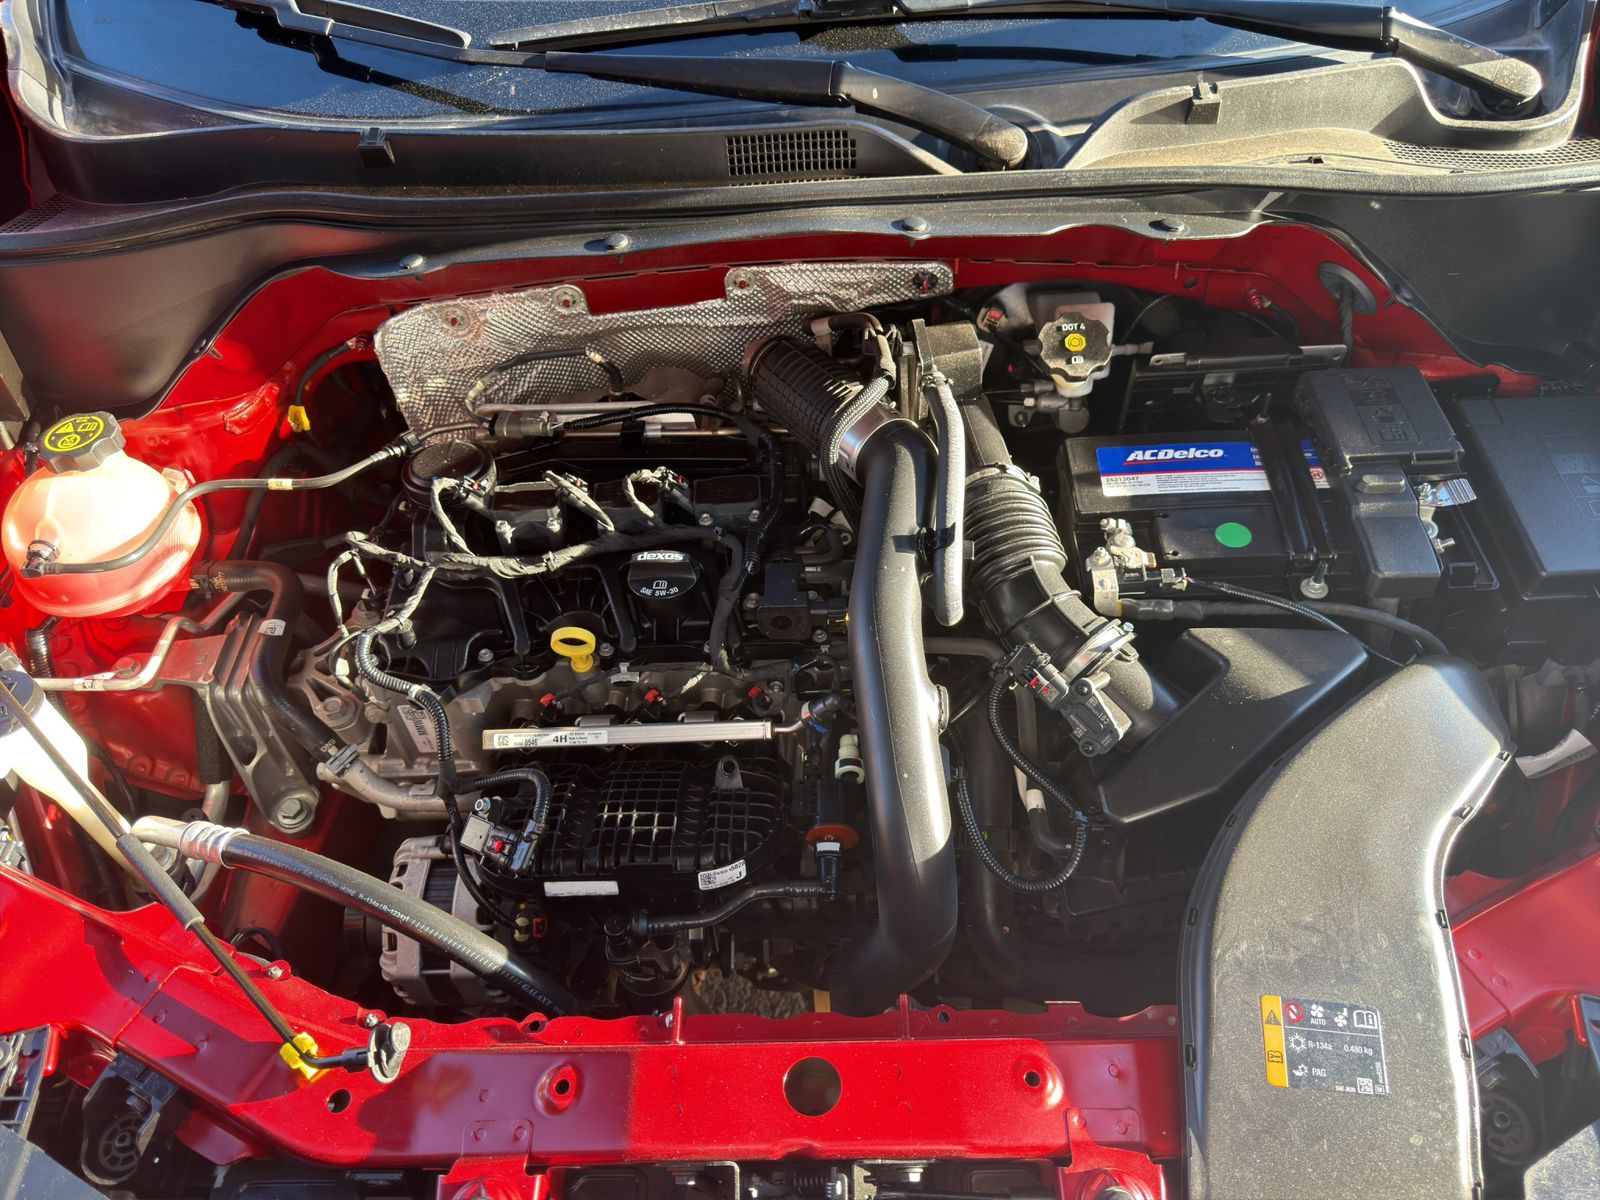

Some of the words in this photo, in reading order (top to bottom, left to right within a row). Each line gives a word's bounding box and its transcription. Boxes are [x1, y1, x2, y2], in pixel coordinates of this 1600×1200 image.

[1062, 323, 1078, 331] DOT
[1126, 447, 1224, 462] ACDelco
[637, 552, 684, 561] dexos
[640, 587, 653, 596] SAE
[655, 587, 679, 597] 5W-30
[553, 735, 567, 744] 4H
[1311, 1018, 1326, 1026] AUTO
[1308, 1041, 1332, 1050] R-134a
[1364, 1046, 1373, 1056] kg
[1312, 1068, 1326, 1077] PAG
